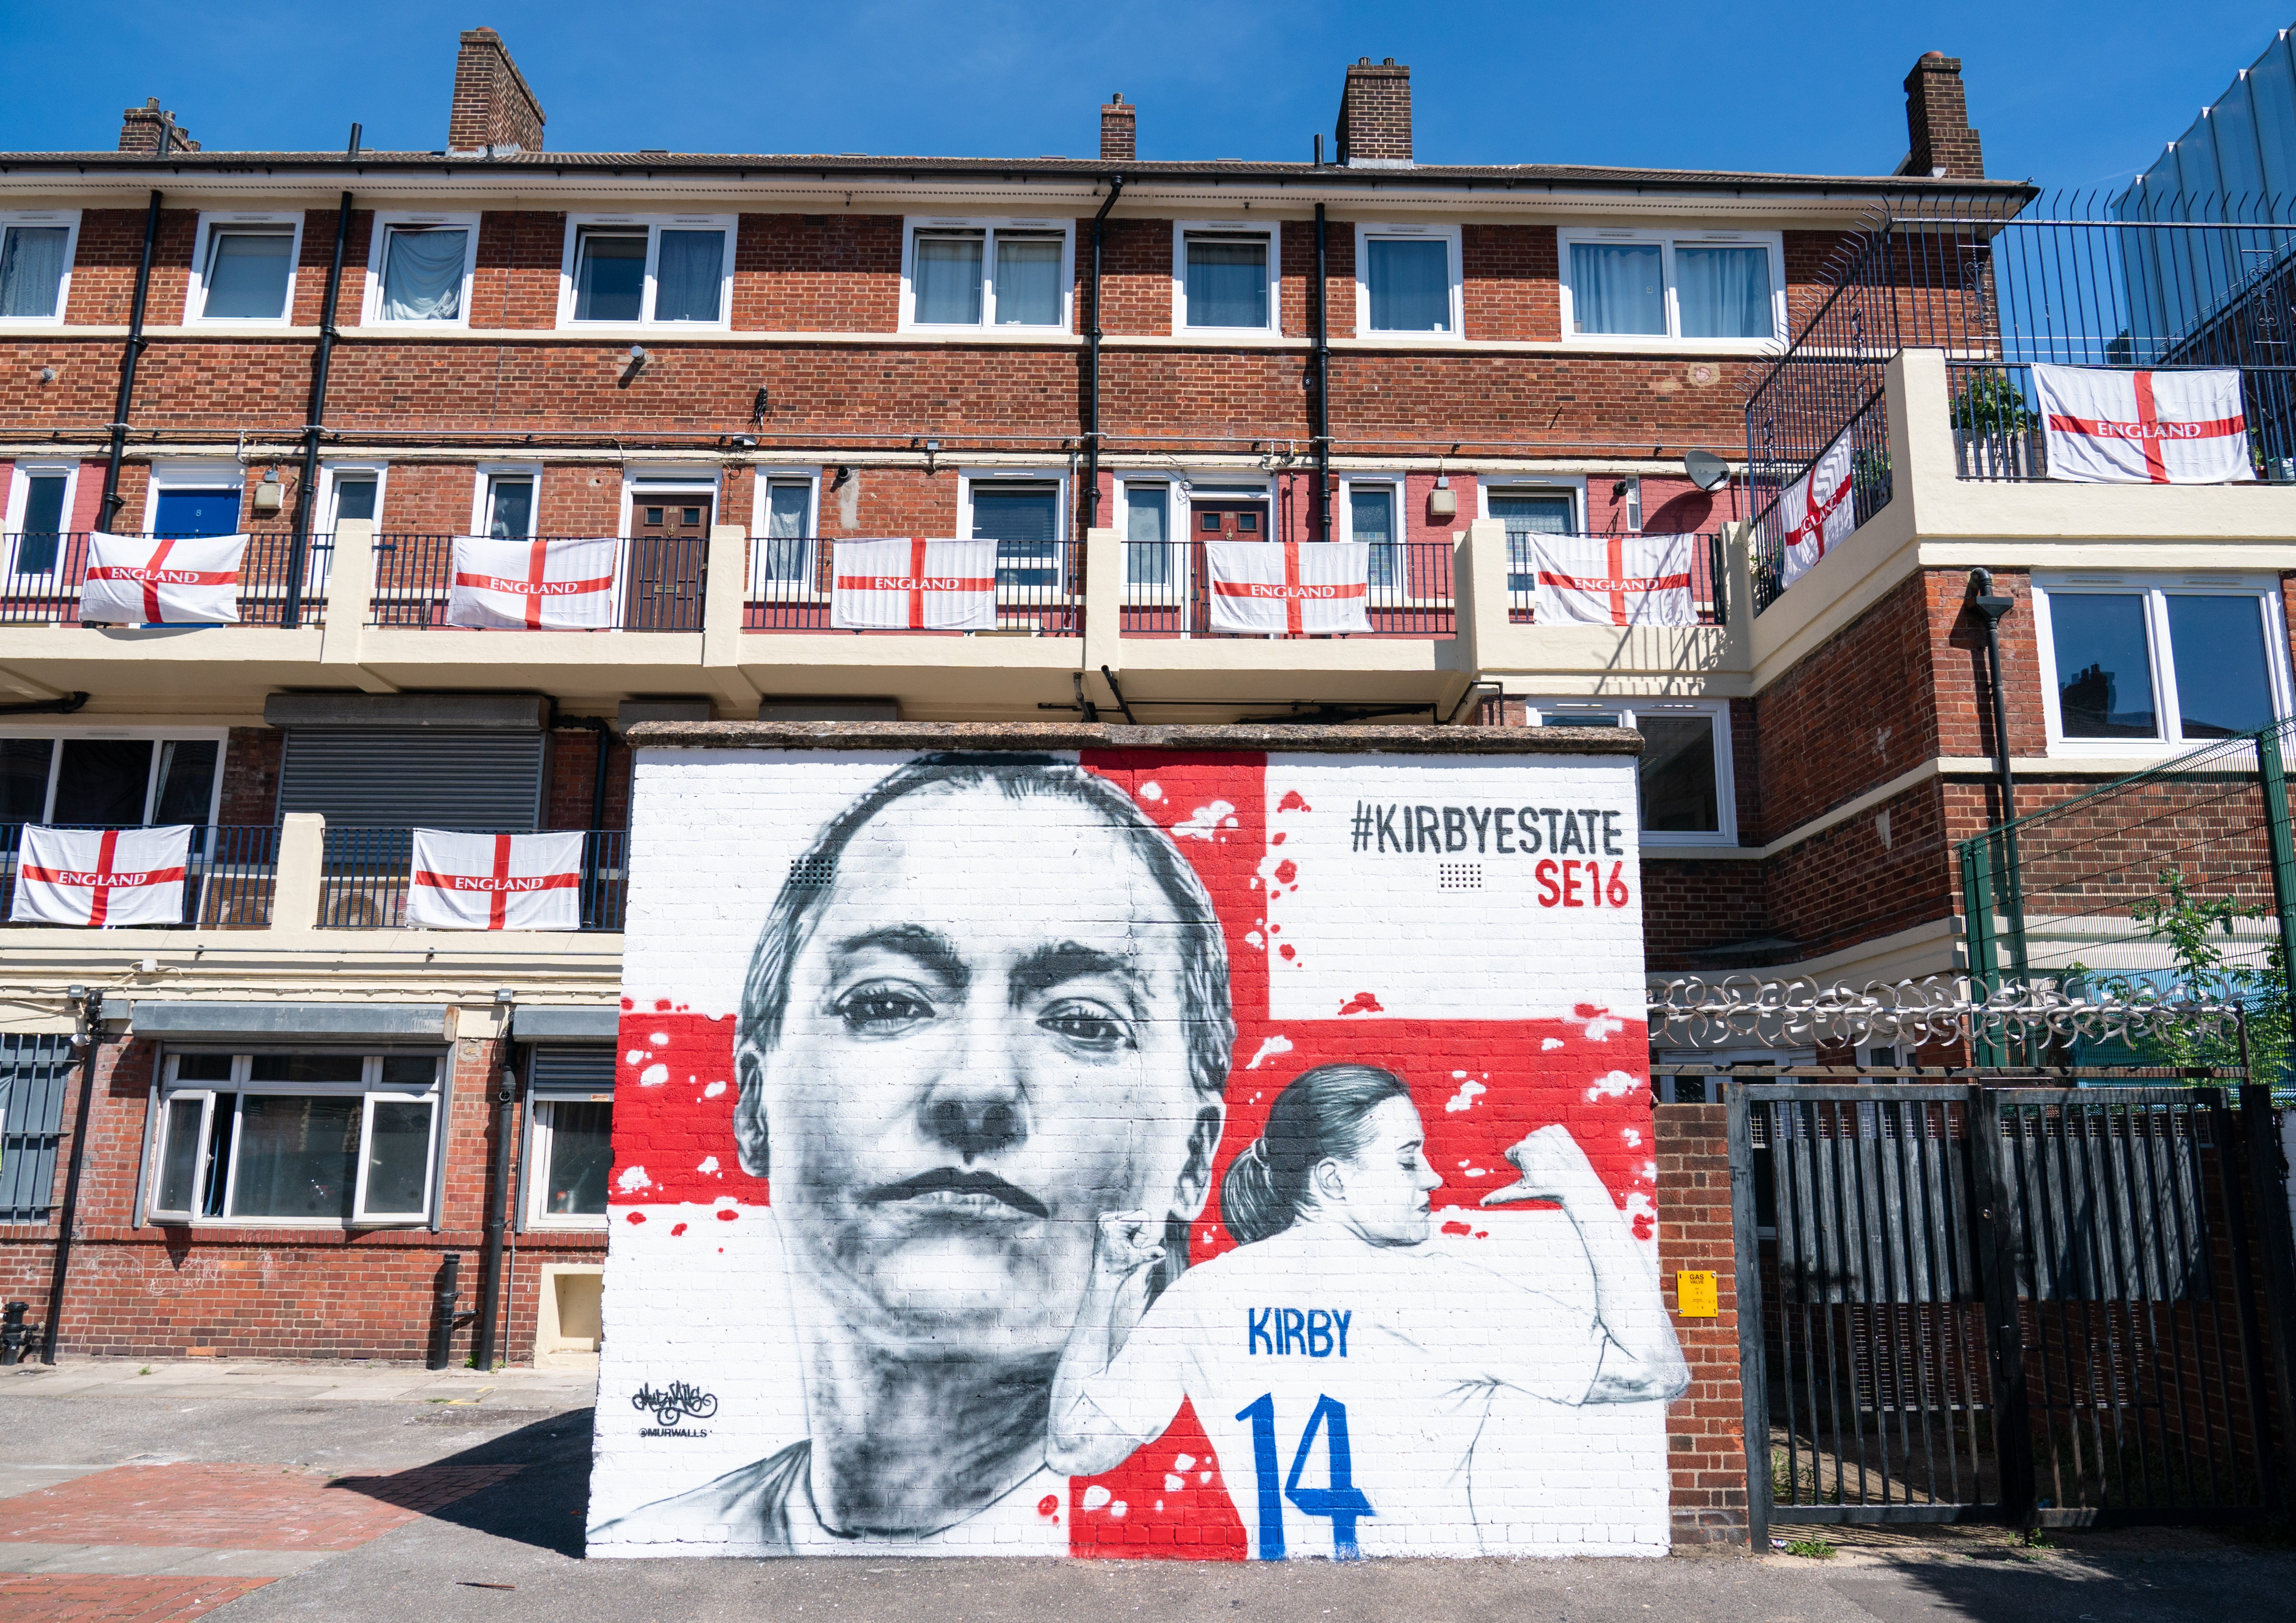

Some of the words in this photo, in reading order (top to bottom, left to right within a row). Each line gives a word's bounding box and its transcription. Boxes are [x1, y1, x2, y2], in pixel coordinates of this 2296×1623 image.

[2097, 421, 2201, 439] ENGLAND
[196, 509, 201, 517] 8
[111, 567, 200, 584] ENGLAND
[490, 578, 578, 594] ENGLAND
[874, 578, 959, 590] ENGLAND
[1251, 585, 1336, 598] ENGLAND
[1574, 578, 1659, 591] ENGLAND
[1351, 799, 1624, 856] #KIRBYESTATE
[58, 872, 147, 886] ENGLAND
[455, 877, 544, 891] ENGLAND
[1535, 858, 1629, 908] SE16
[1249, 1307, 1352, 1358] KIRBY
[639, 1428, 708, 1438] @MURWALLS
[1235, 1392, 1378, 1560] 14
